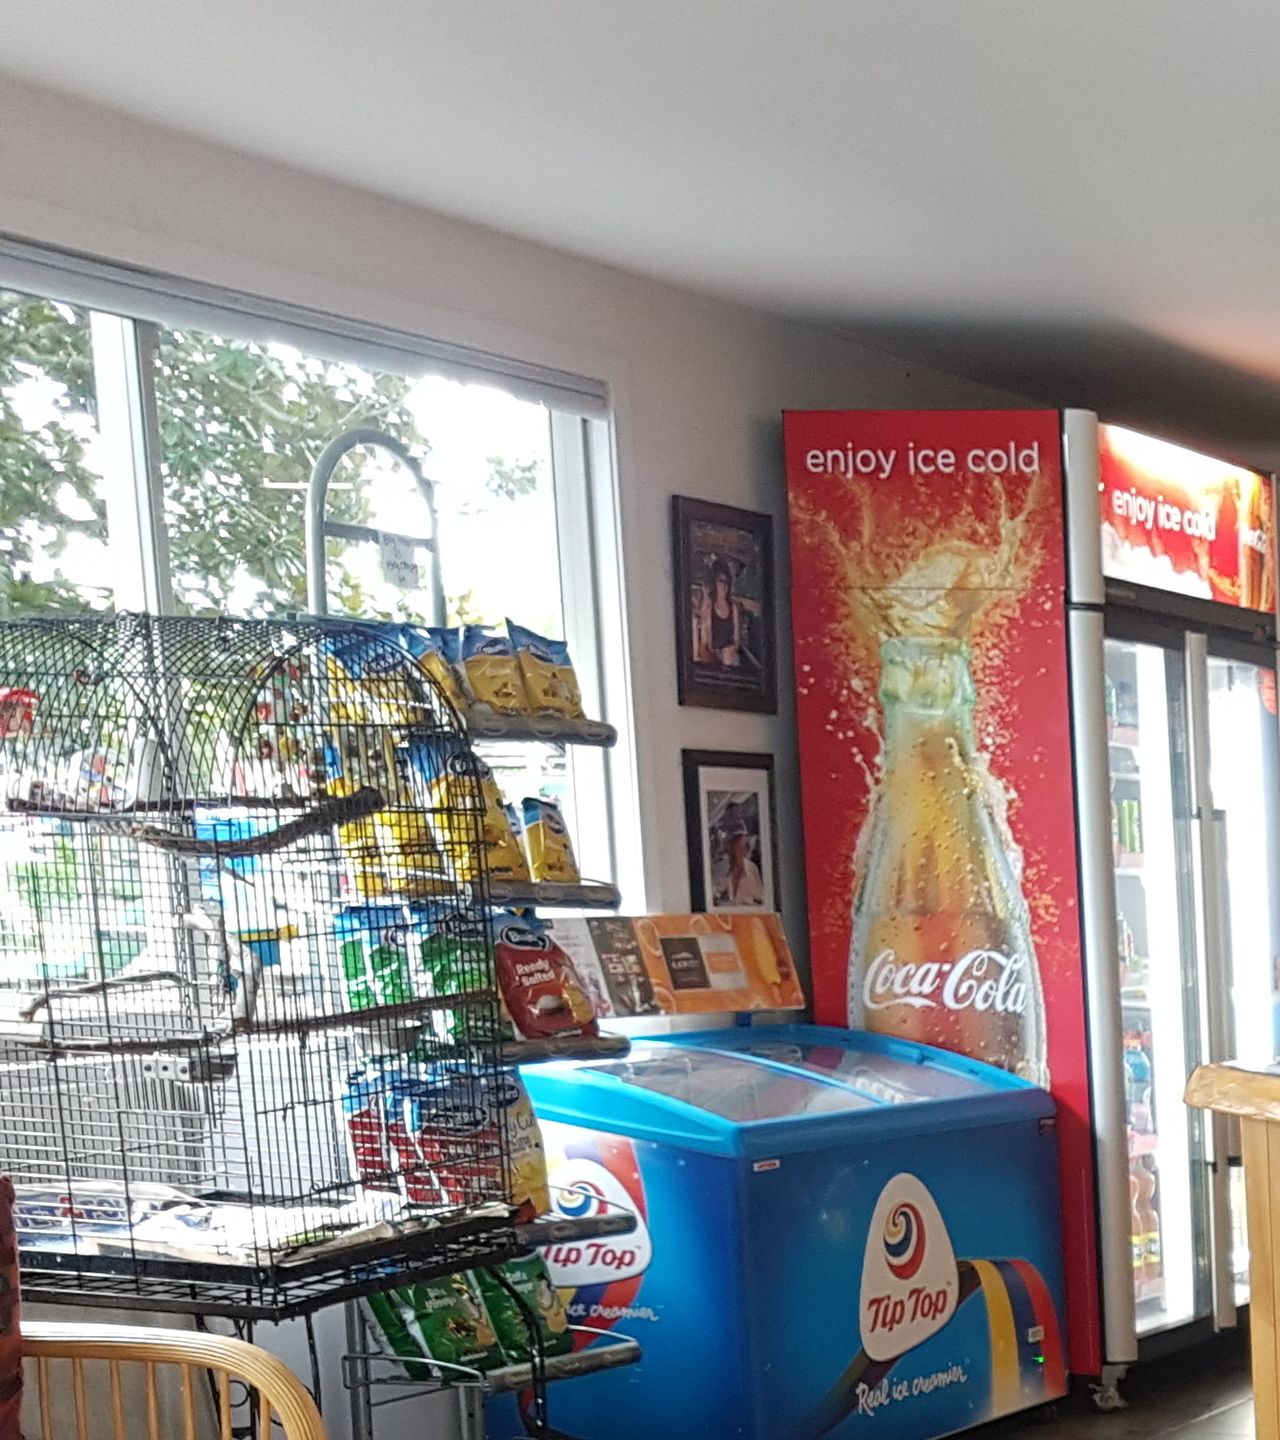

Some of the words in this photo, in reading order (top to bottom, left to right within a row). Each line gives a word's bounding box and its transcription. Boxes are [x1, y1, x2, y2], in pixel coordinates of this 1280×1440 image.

[806, 441, 897, 478] enjoy
[909, 441, 955, 473] ice
[967, 440, 1041, 473] cold
[1112, 487, 1156, 529] enjoy
[1157, 495, 1181, 531] ice
[1183, 509, 1215, 540] cold
[515, 958, 550, 976] Ready
[863, 948, 1027, 1012] Coca-Cola
[586, 1243, 636, 1270] Top
[868, 1294, 905, 1332] Tip
[908, 1286, 948, 1322] Top
[856, 1378, 891, 1416] Real
[892, 1378, 909, 1401] ice
[912, 1362, 968, 1396] creamier
